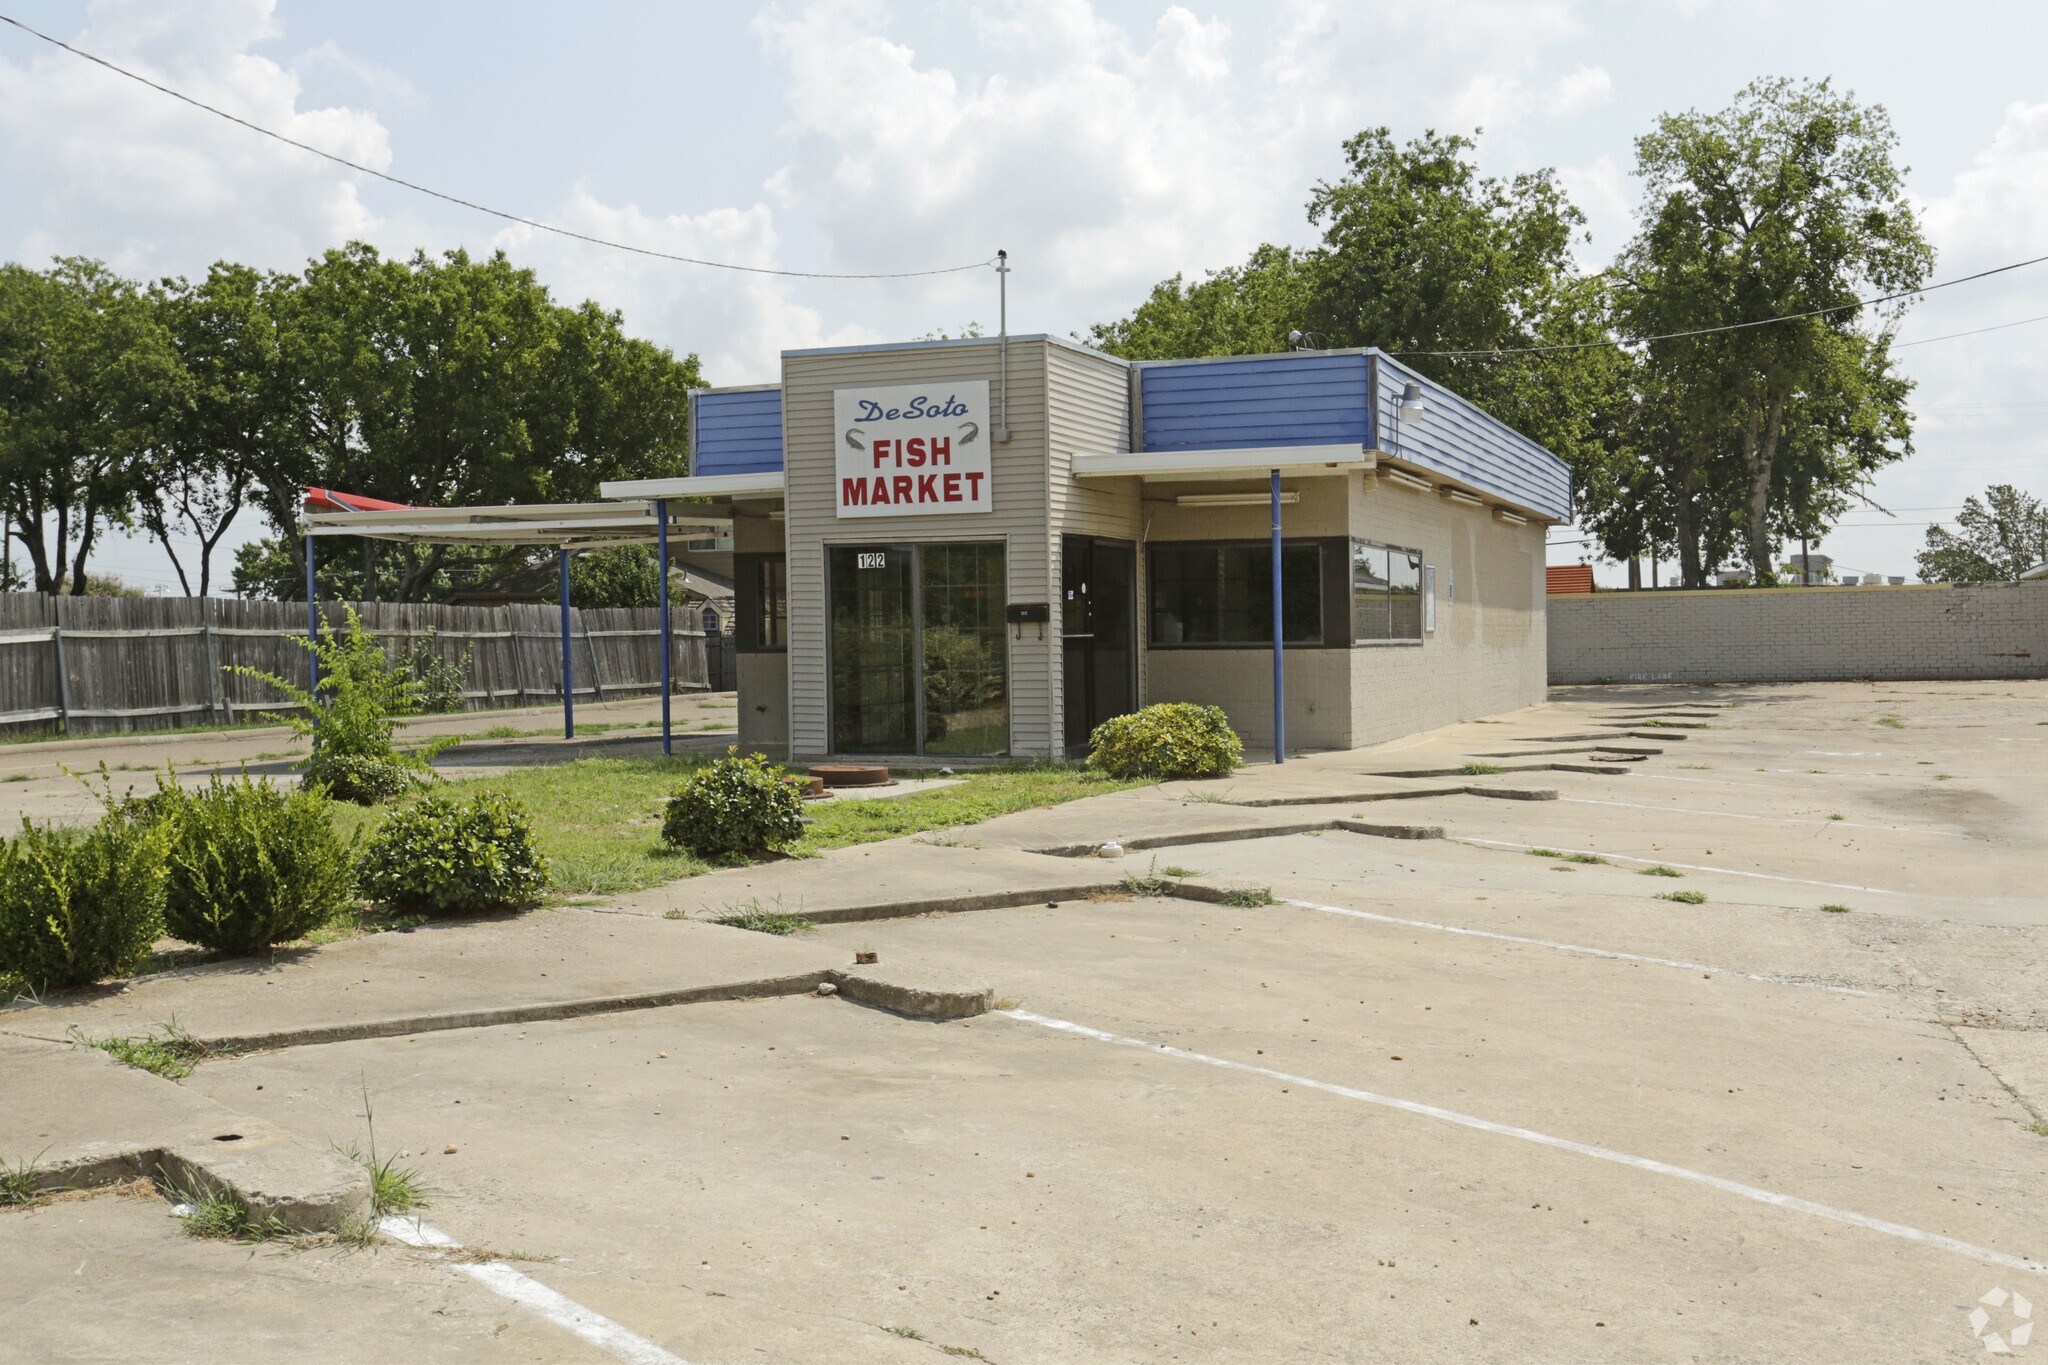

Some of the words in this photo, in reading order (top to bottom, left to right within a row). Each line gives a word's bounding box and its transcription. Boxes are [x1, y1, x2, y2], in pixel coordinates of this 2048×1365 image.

[854, 395, 968, 422] DeSoto
[873, 437, 951, 468] FISH
[842, 472, 984, 506] MARKET
[859, 553, 884, 568] 122
[1651, 672, 1672, 680] LANE
